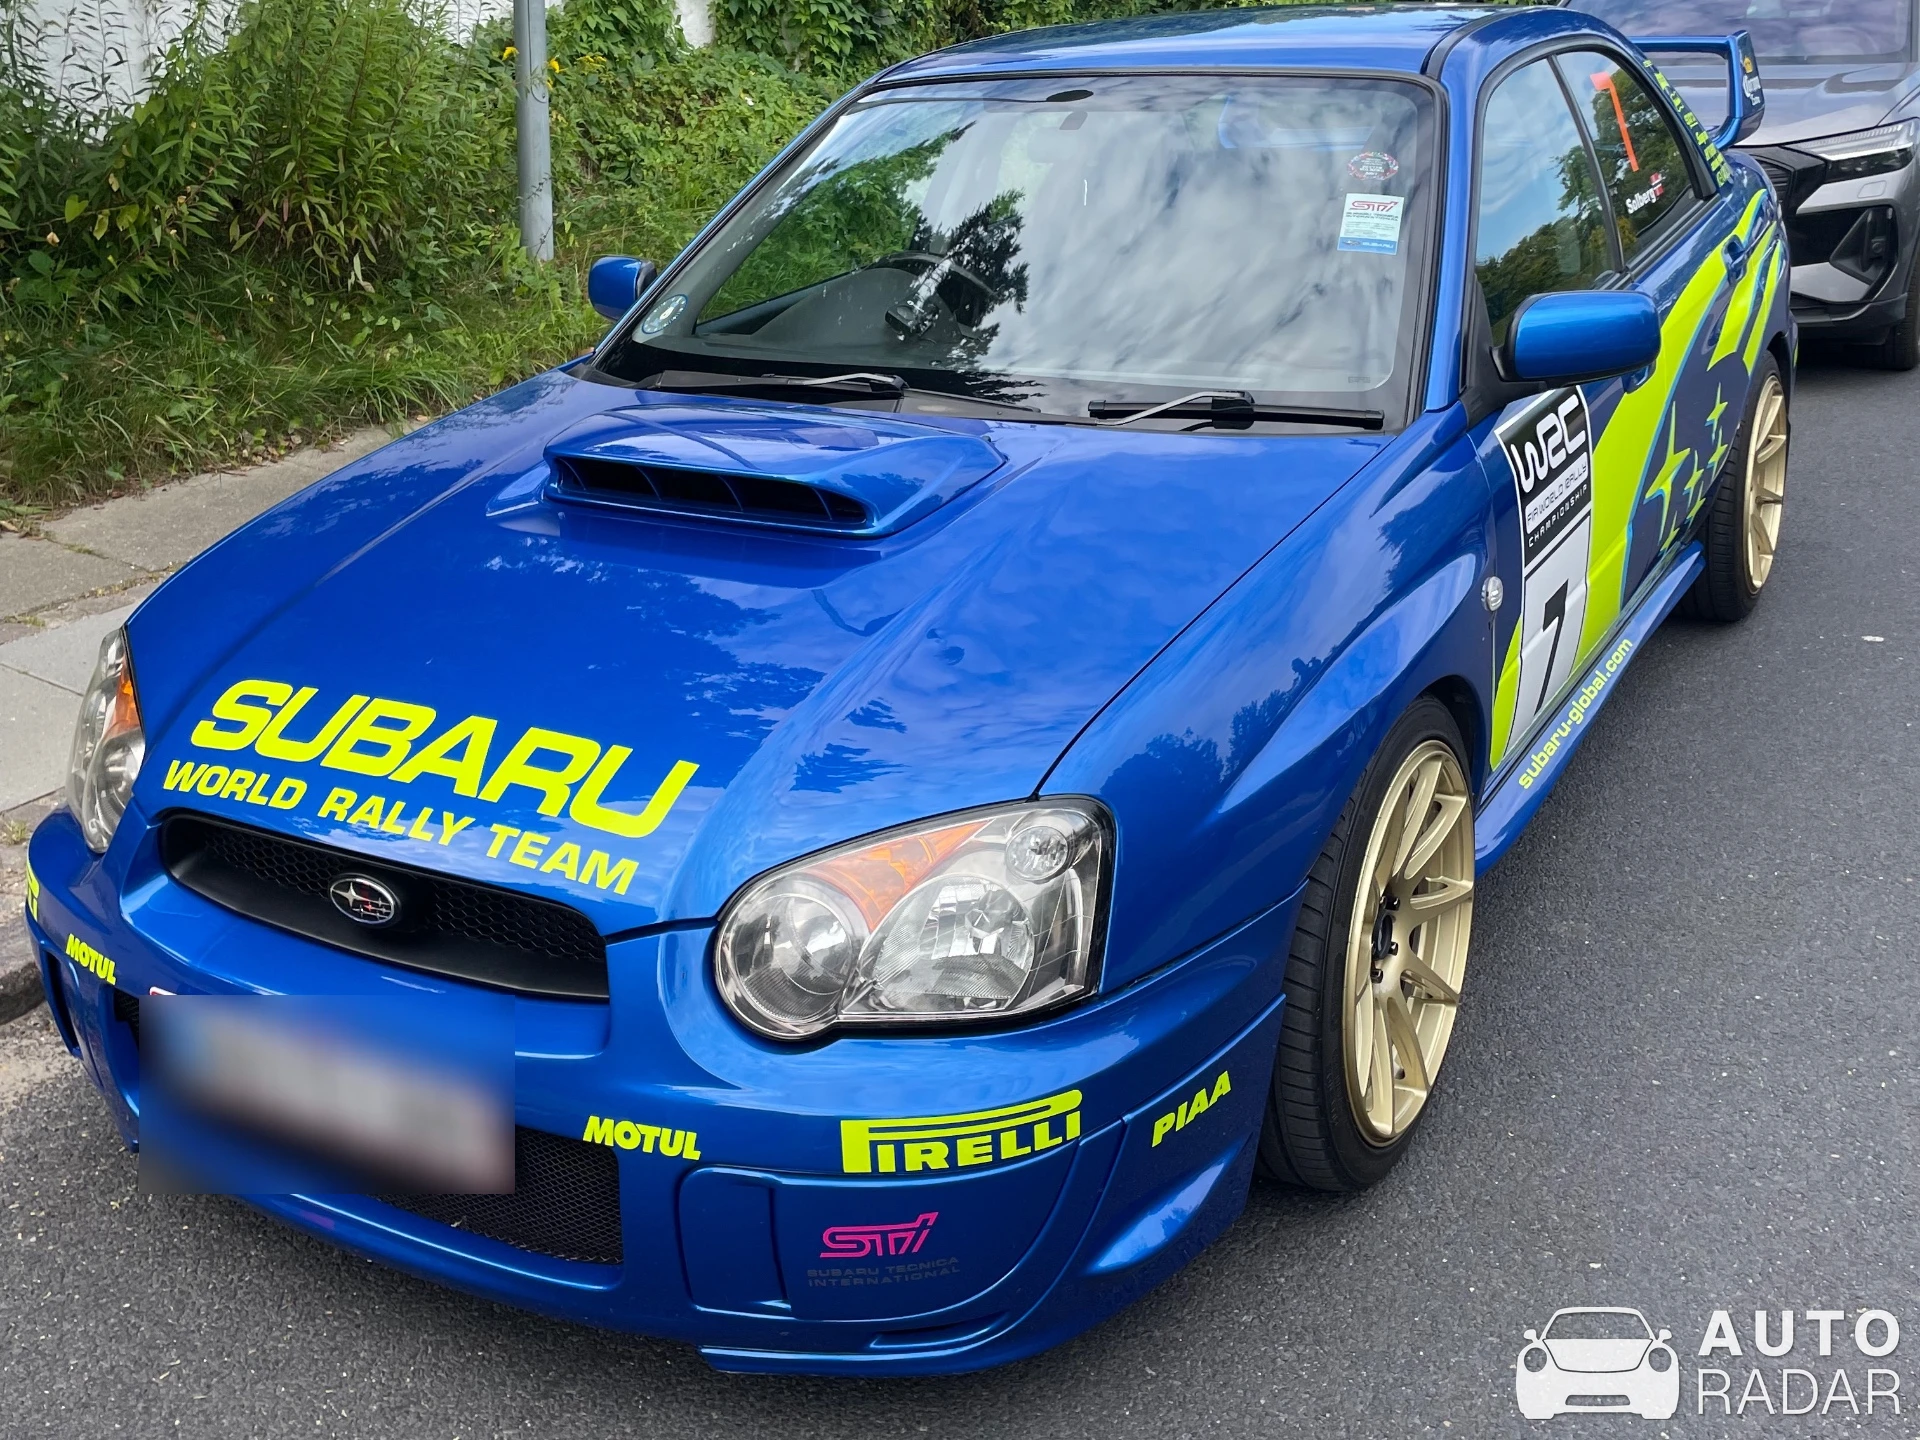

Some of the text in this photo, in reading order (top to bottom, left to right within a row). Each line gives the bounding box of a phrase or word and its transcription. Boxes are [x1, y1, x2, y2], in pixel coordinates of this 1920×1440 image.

[1625, 187, 1656, 214] Solberg
[1528, 484, 1587, 548] CHAMPIONSHIP
[1533, 578, 1569, 717] 7
[1518, 637, 1634, 790] subaru-global.com
[191, 680, 700, 838] SUBARU
[163, 760, 639, 896] WORLD RALLY TEAM
[65, 933, 117, 986] MOTUL
[582, 1115, 701, 1161] MOTUL
[840, 1089, 1083, 1174] PIRELLI
[1152, 1070, 1232, 1148] PIAA
[807, 1256, 960, 1278] SUBARU TECNICA
[808, 1265, 961, 1288] INTERNATIONAL
